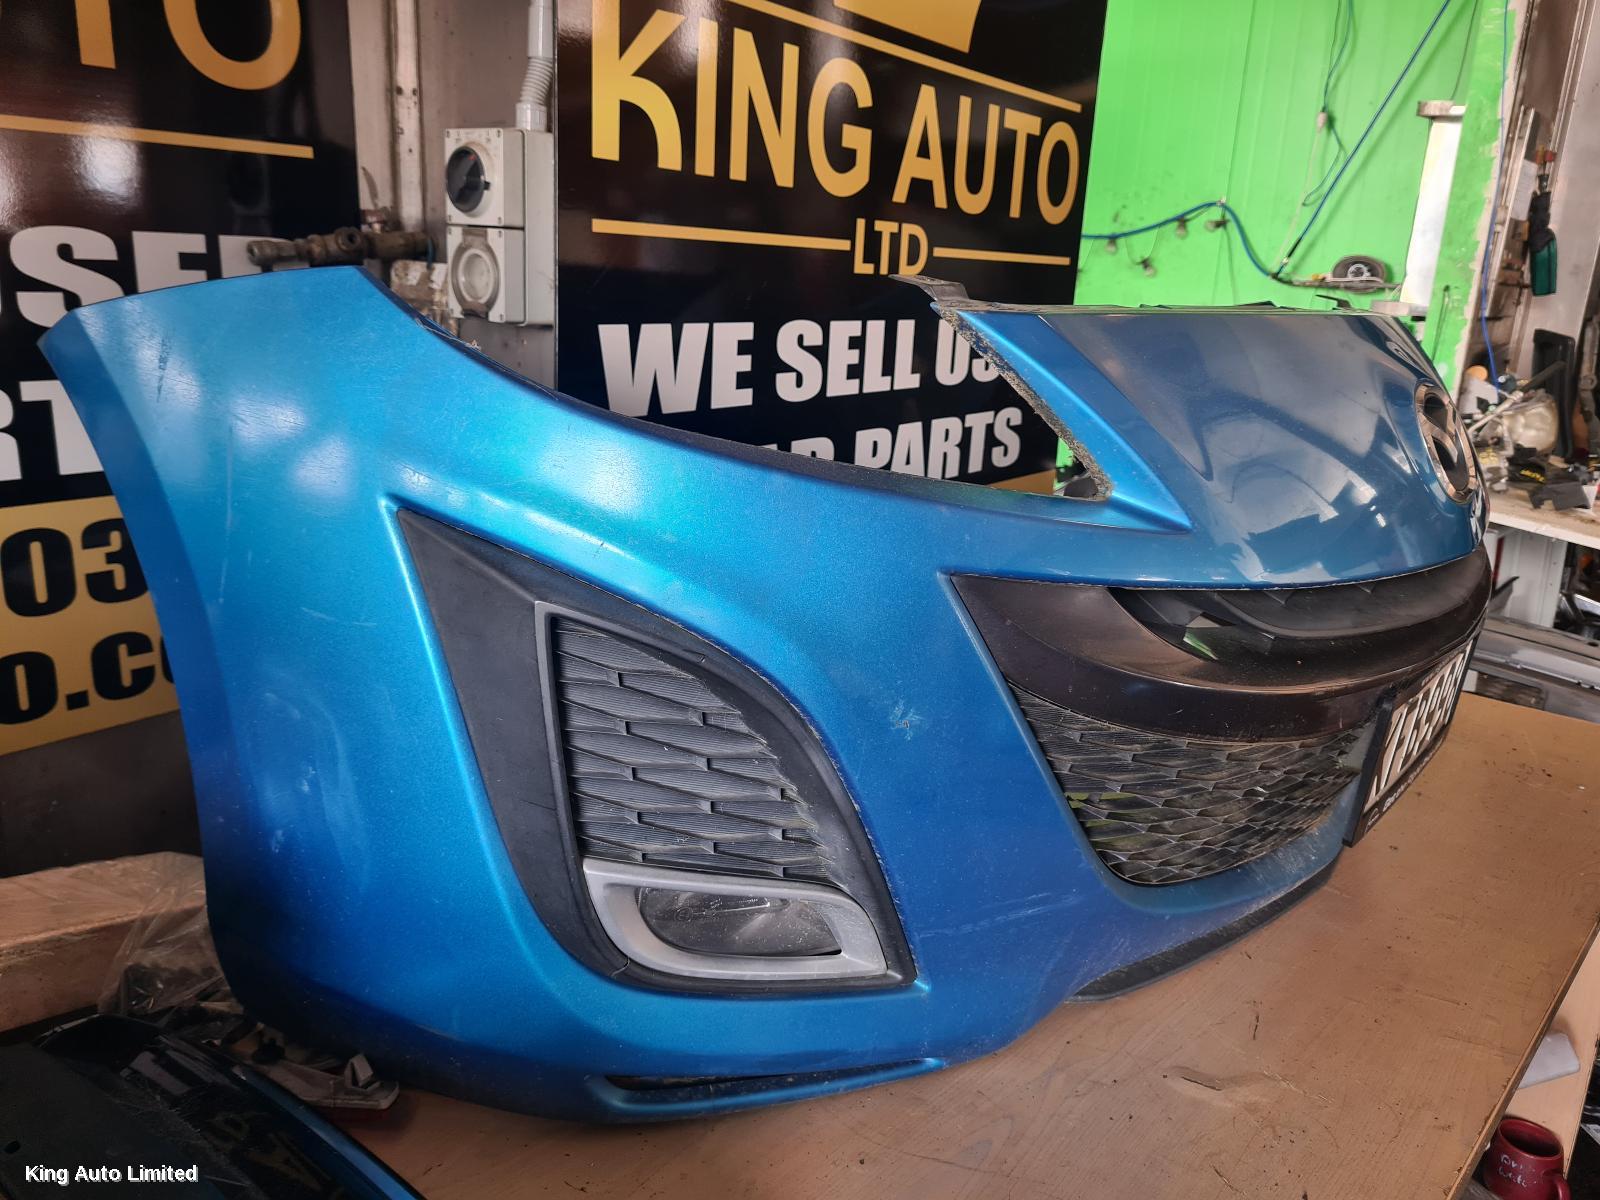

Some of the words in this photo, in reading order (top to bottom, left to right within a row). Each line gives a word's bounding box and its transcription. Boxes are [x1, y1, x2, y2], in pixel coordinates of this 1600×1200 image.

[591, 0, 874, 198] KING
[891, 83, 1080, 225] AUTO
[853, 217, 929, 276] LTD
[597, 321, 755, 417] WE
[775, 319, 920, 402] SELL
[854, 406, 1023, 480] PARTS
